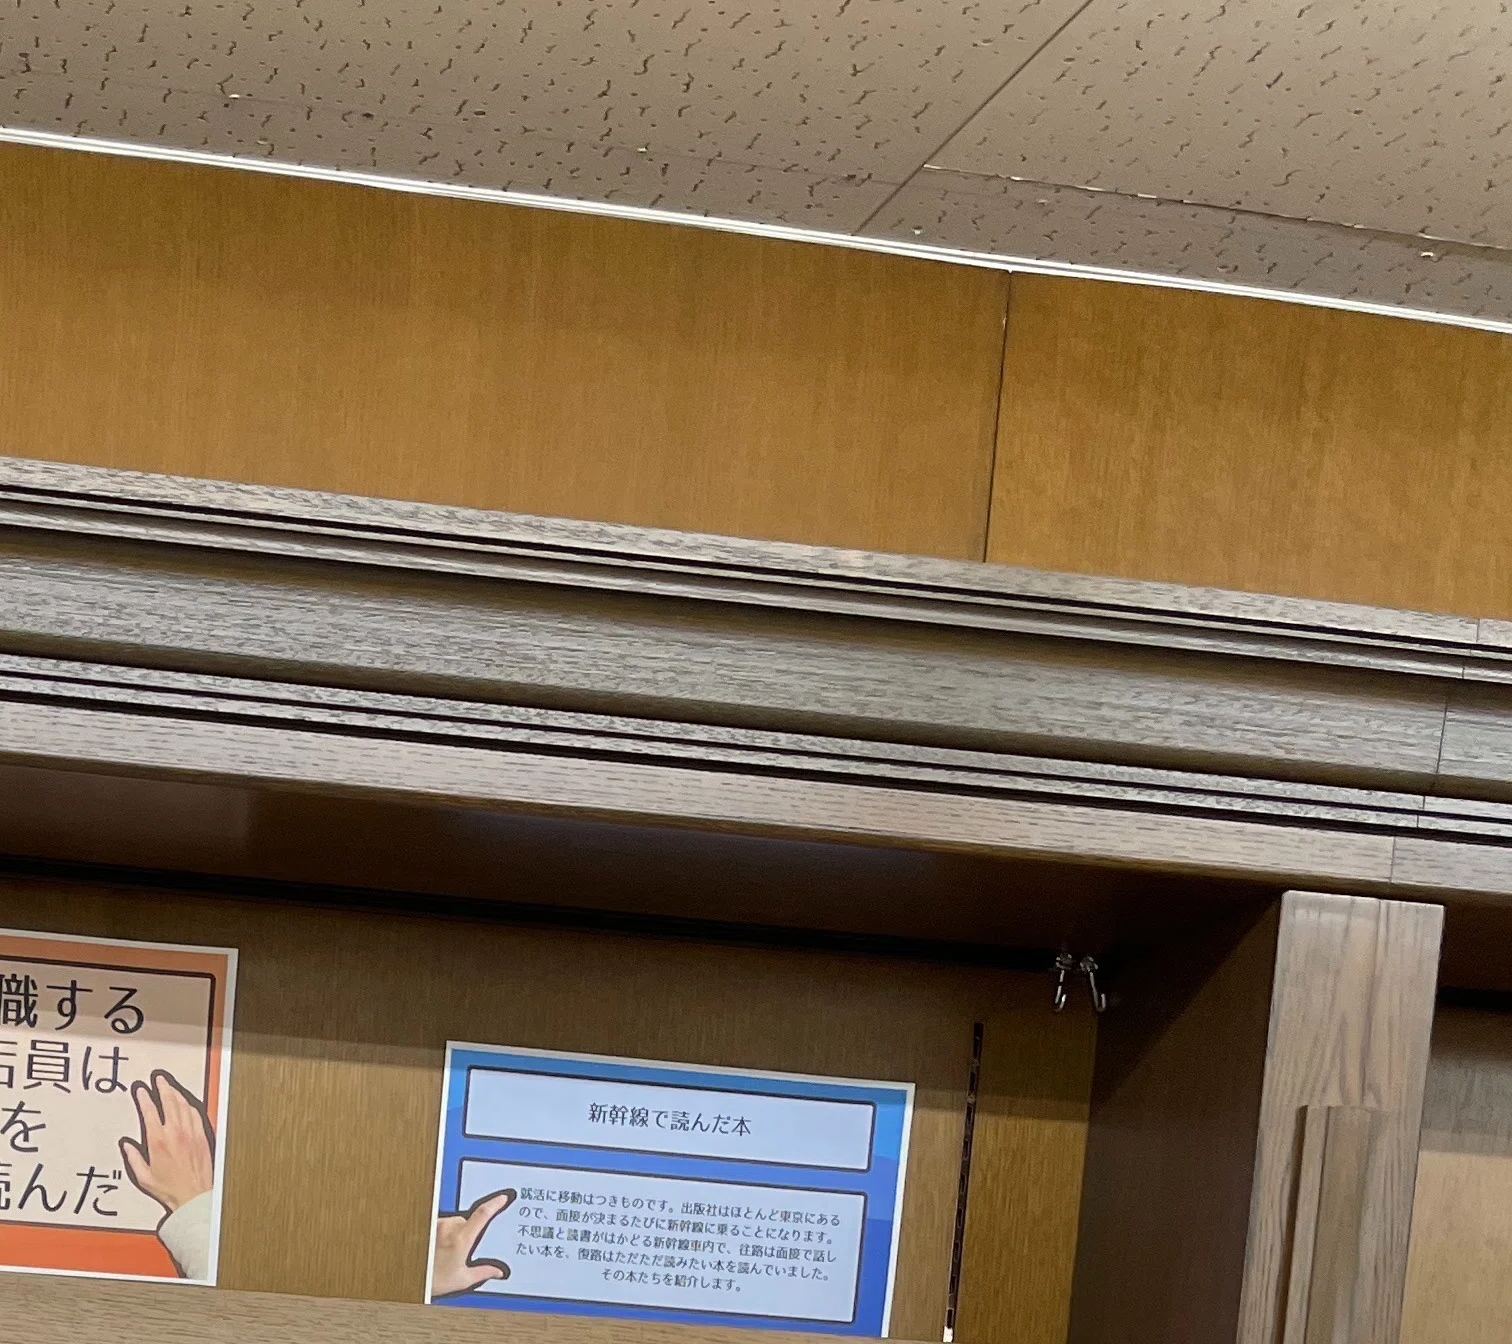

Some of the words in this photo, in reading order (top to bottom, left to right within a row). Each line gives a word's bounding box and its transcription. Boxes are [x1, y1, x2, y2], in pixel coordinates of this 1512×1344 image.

[588, 1102, 752, 1137] 新幹線で読んだ本
[601, 1267, 742, 1294] その本たちを紹介します。
